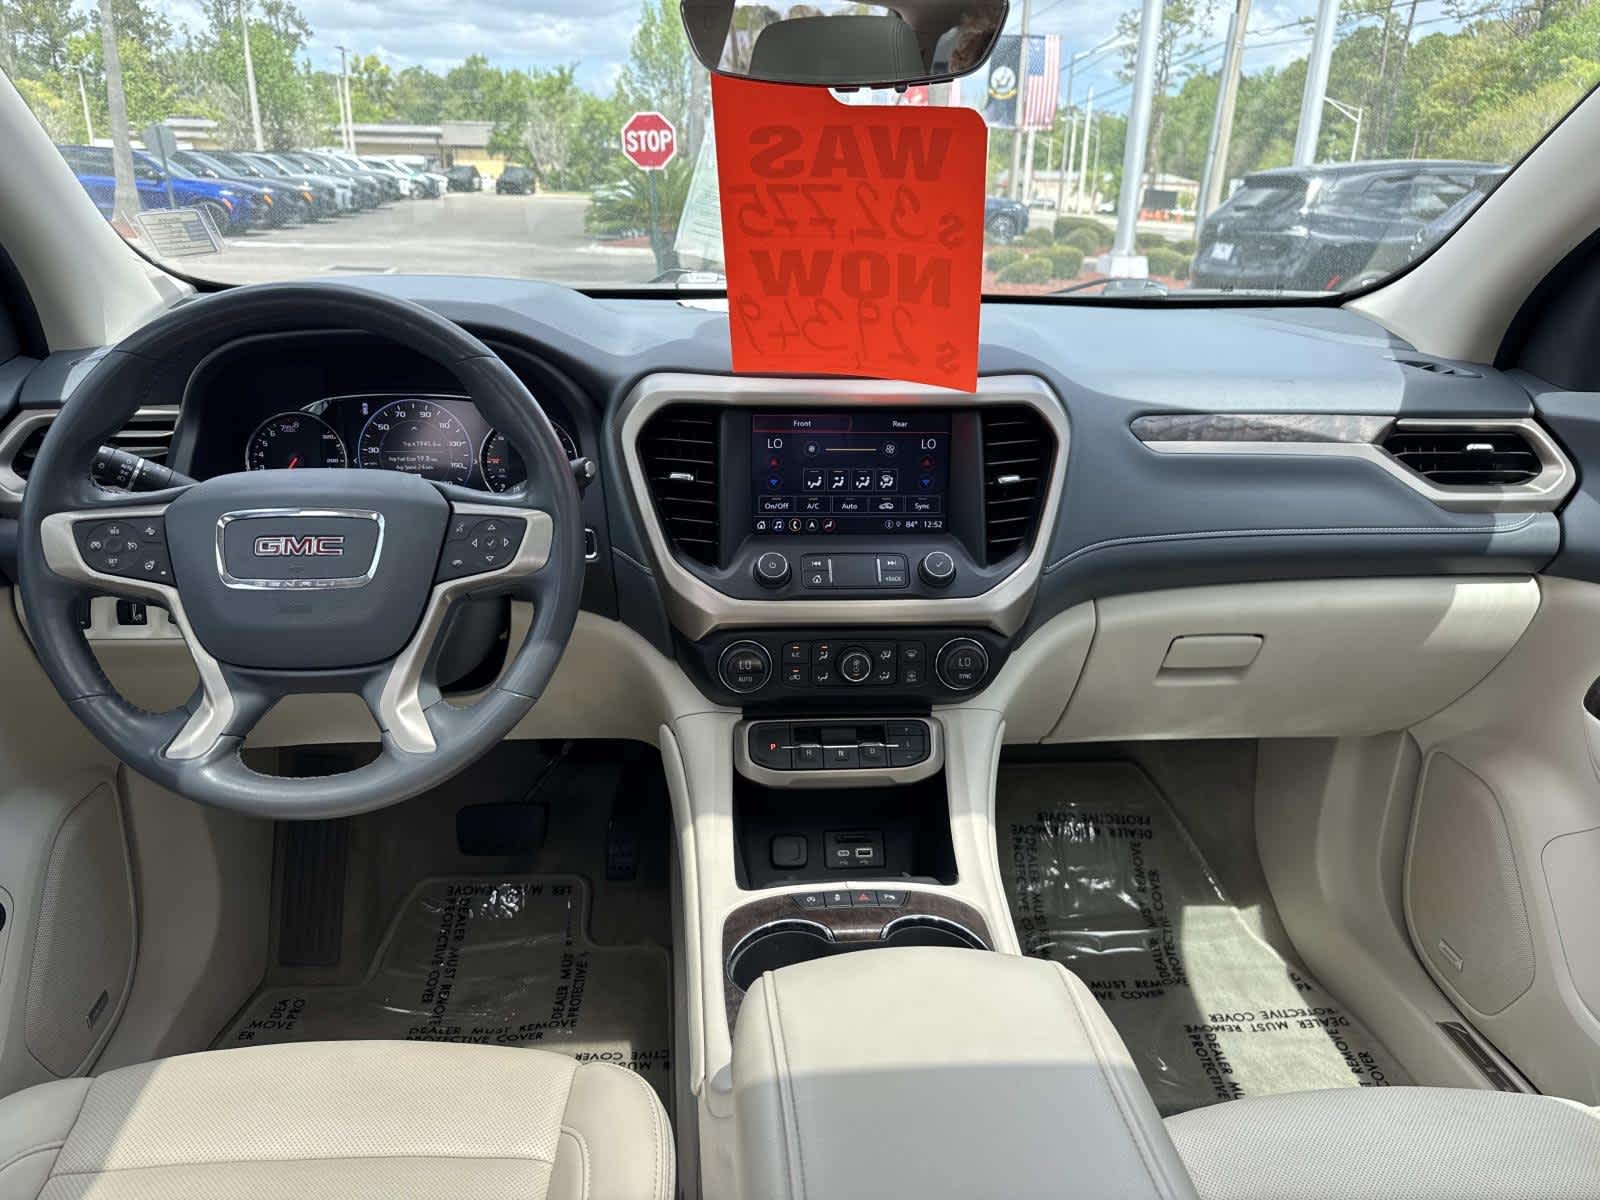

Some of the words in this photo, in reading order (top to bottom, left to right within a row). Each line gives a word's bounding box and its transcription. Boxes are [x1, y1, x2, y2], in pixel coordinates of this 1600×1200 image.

[626, 129, 672, 153] STOP
[767, 438, 783, 449] LO
[921, 438, 937, 450] LO
[764, 502, 790, 511] On/Off
[806, 502, 820, 510] A/C
[841, 502, 858, 510] Auto
[914, 502, 931, 512] Sync
[923, 520, 943, 528] 12:52
[254, 536, 345, 556] GMC
[1149, 868, 1164, 912] COVER
[1208, 1011, 1256, 1023] COVER
[1298, 1016, 1351, 1030] DEALER
[409, 1026, 461, 1035] DEALER
[1250, 1021, 1289, 1033] MUST
[496, 1031, 544, 1043] COVER
[575, 1051, 624, 1062] COVER
[1204, 1032, 1233, 1074] DEALER
